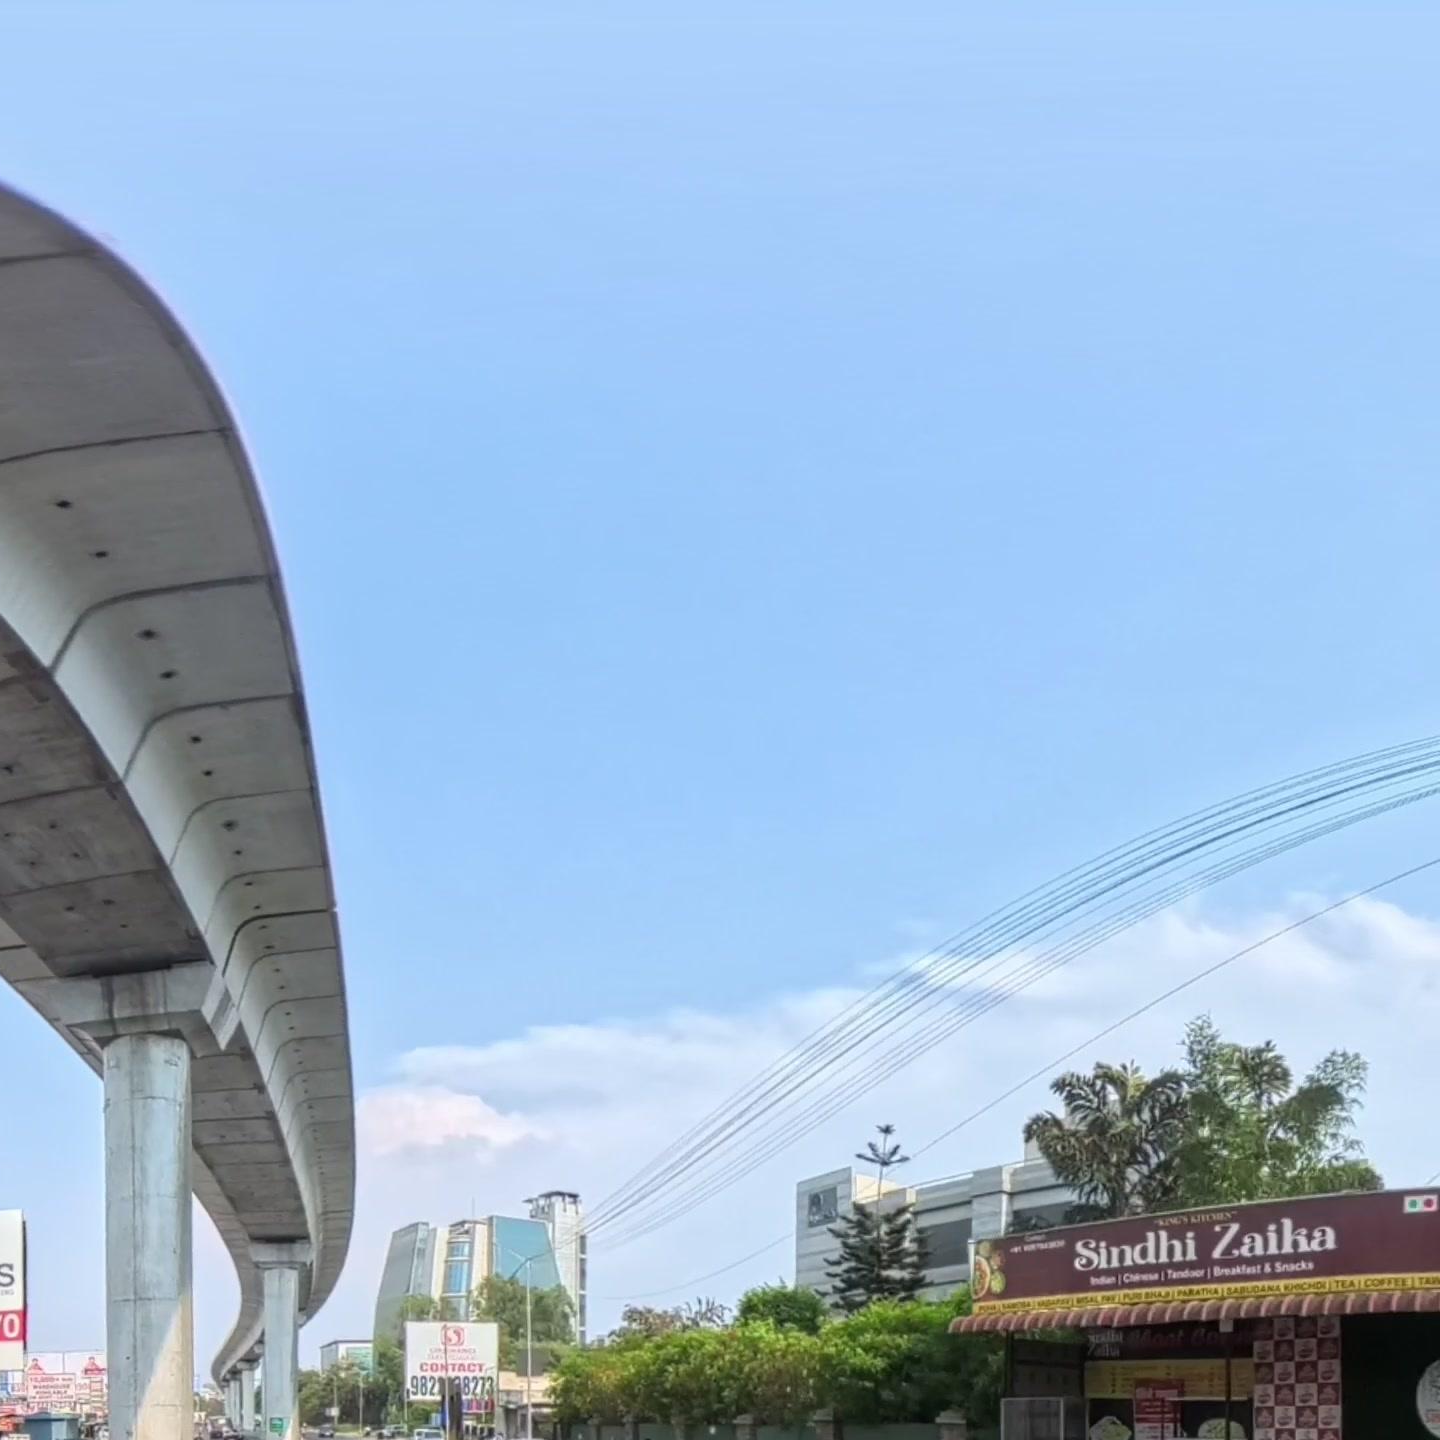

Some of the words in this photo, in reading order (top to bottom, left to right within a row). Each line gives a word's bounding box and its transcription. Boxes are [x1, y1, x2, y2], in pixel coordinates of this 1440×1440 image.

[1074, 1229, 1198, 1271] Sindhi
[1211, 1217, 1338, 1260] Zaika
[1090, 1275, 1117, 1286] Indian
[1122, 1271, 1160, 1283] Chinese
[1167, 1267, 1205, 1280] Tandoor
[1213, 1261, 1261, 1277] Breakfast
[1263, 1262, 1272, 1274] &
[1274, 1259, 1315, 1273] Snacks
[1178, 1286, 1220, 1297] PARATHA
[1226, 1284, 1281, 1296] SABUDANA
[1284, 1281, 1327, 1293] KHICHDI
[1335, 1279, 1357, 1289] TEA
[1364, 1277, 1409, 1288] COFFEE
[420, 1362, 485, 1373] CONTACT
